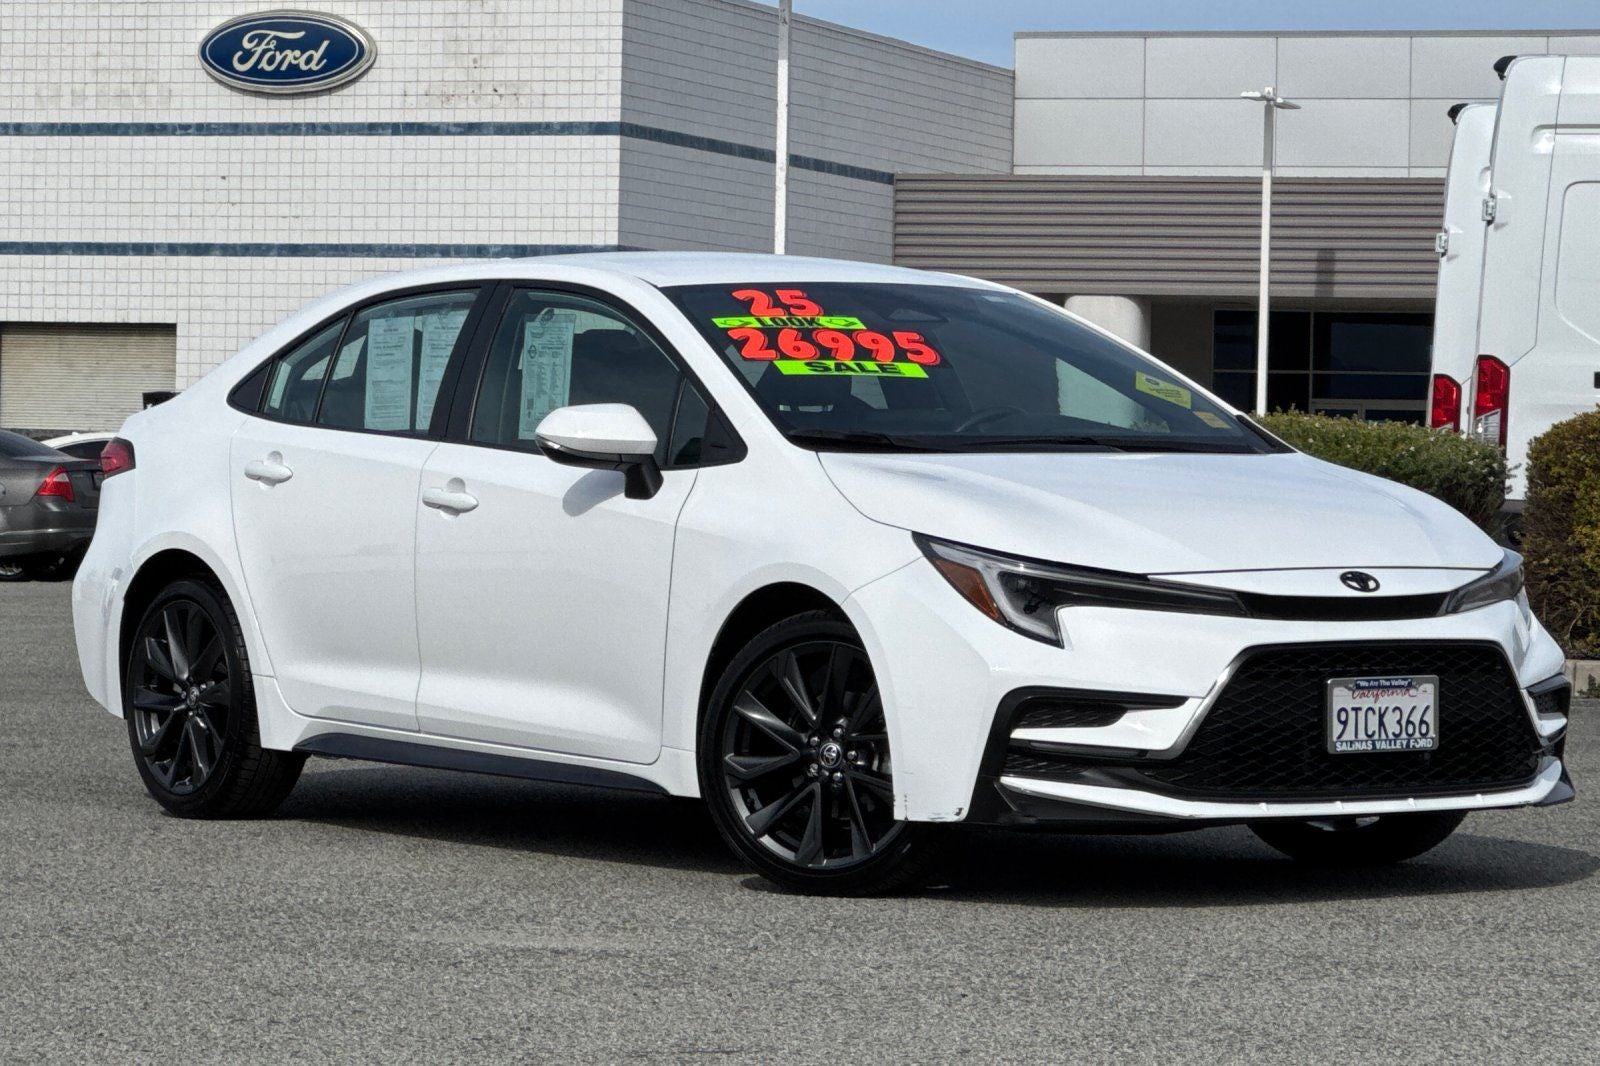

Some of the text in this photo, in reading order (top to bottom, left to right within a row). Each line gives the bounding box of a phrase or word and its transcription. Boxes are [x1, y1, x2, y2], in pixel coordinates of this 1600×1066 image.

[232, 30, 330, 72] Ford
[732, 289, 824, 316] 25
[756, 317, 822, 328] LOOK
[726, 327, 941, 365] 26995
[804, 362, 903, 375] SALE
[1336, 705, 1430, 739] 9TCK366
[1335, 738, 1433, 752] SALINAS VALLEY FORD
